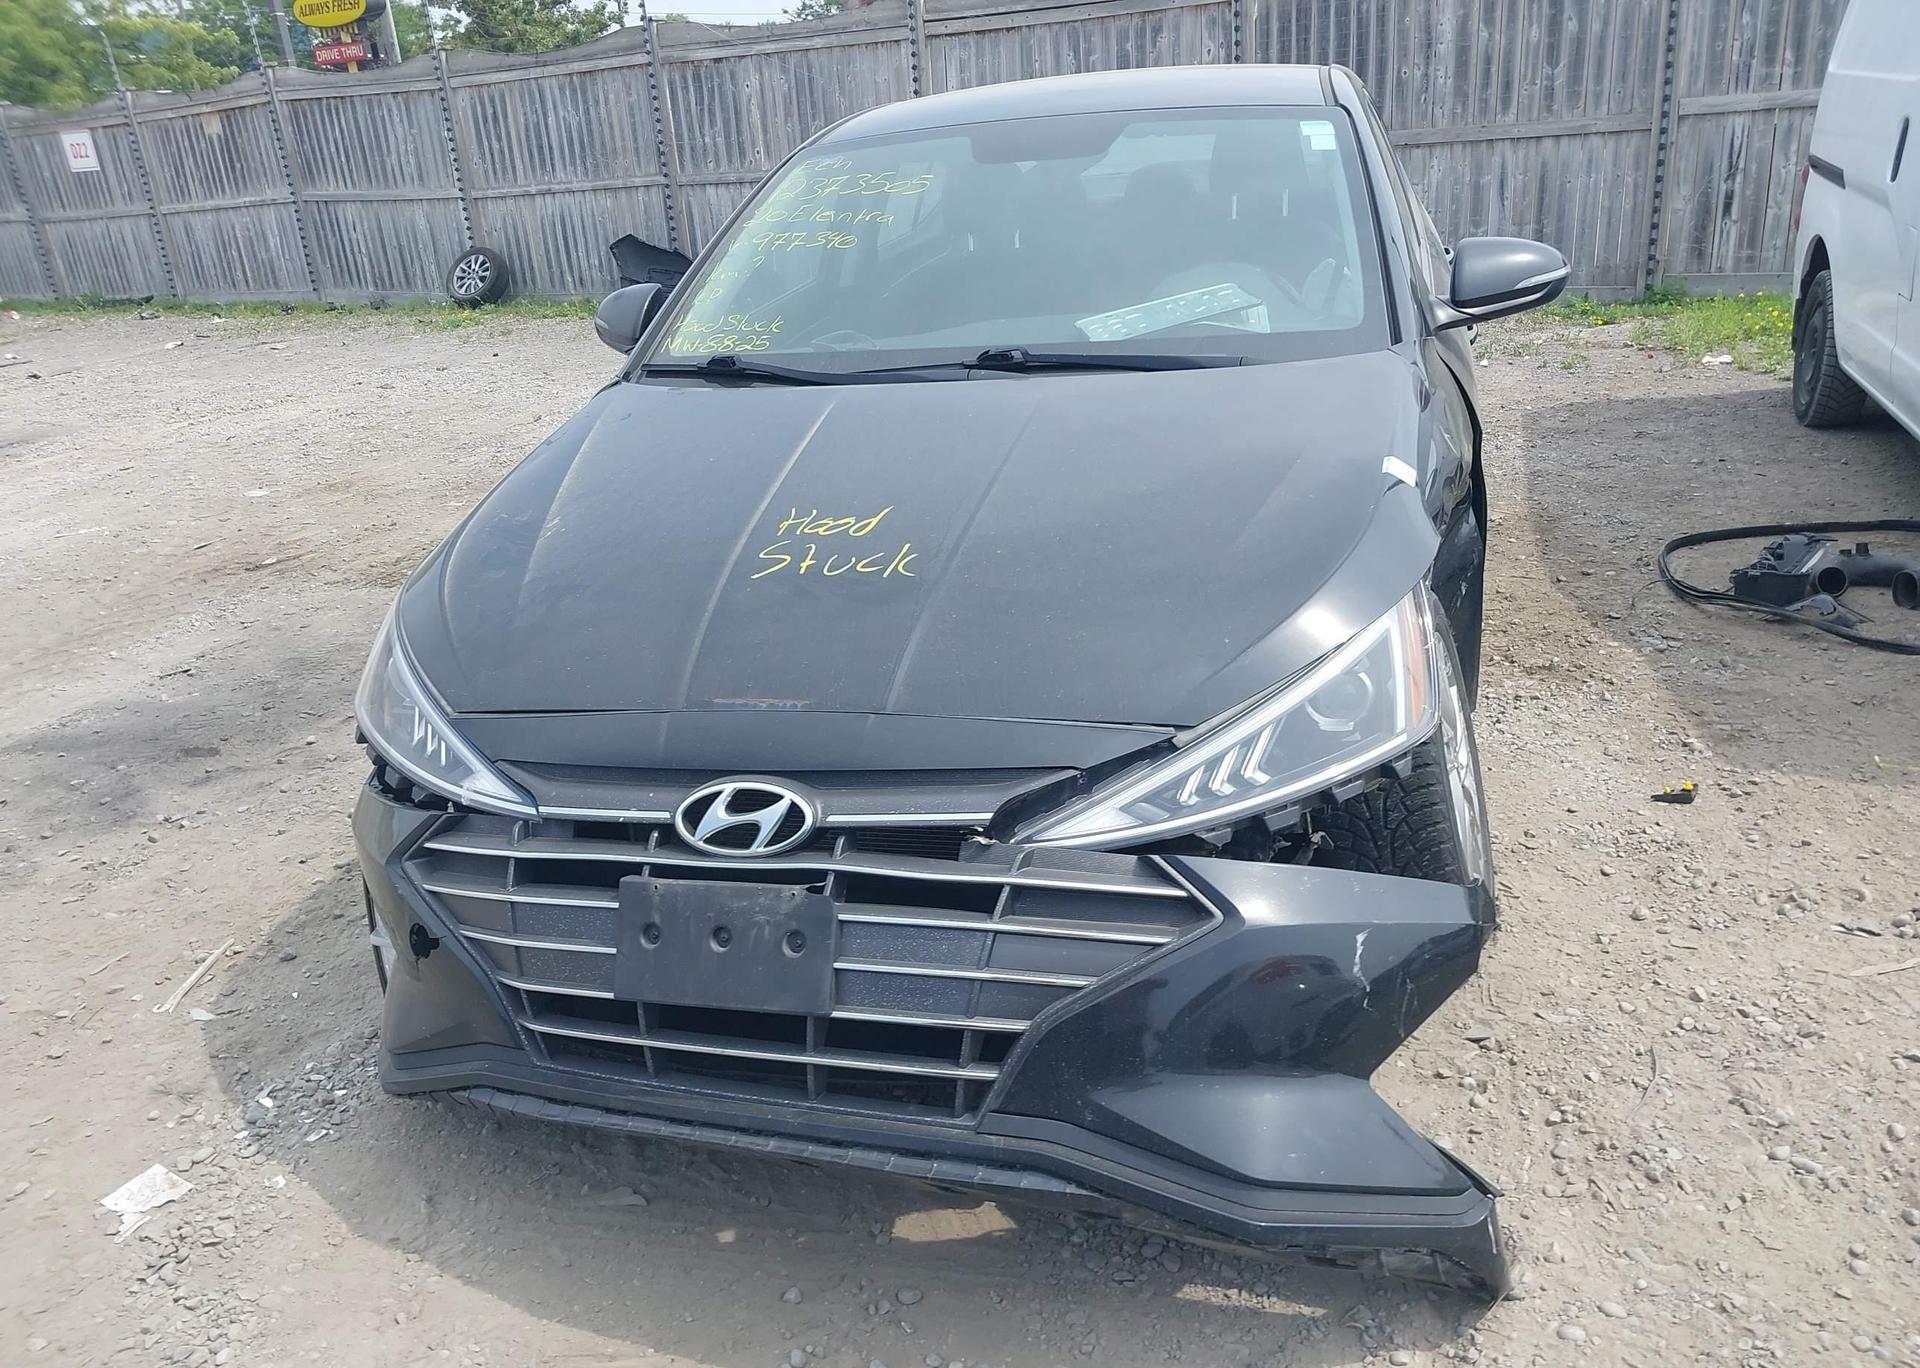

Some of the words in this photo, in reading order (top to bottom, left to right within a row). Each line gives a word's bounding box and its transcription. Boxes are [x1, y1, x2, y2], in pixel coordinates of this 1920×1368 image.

[299, 1, 331, 18] ALWAYS
[332, 0, 360, 13] FRESH
[315, 49, 340, 62] DRIVE
[341, 44, 364, 58] THRU
[777, 504, 896, 537] Hood
